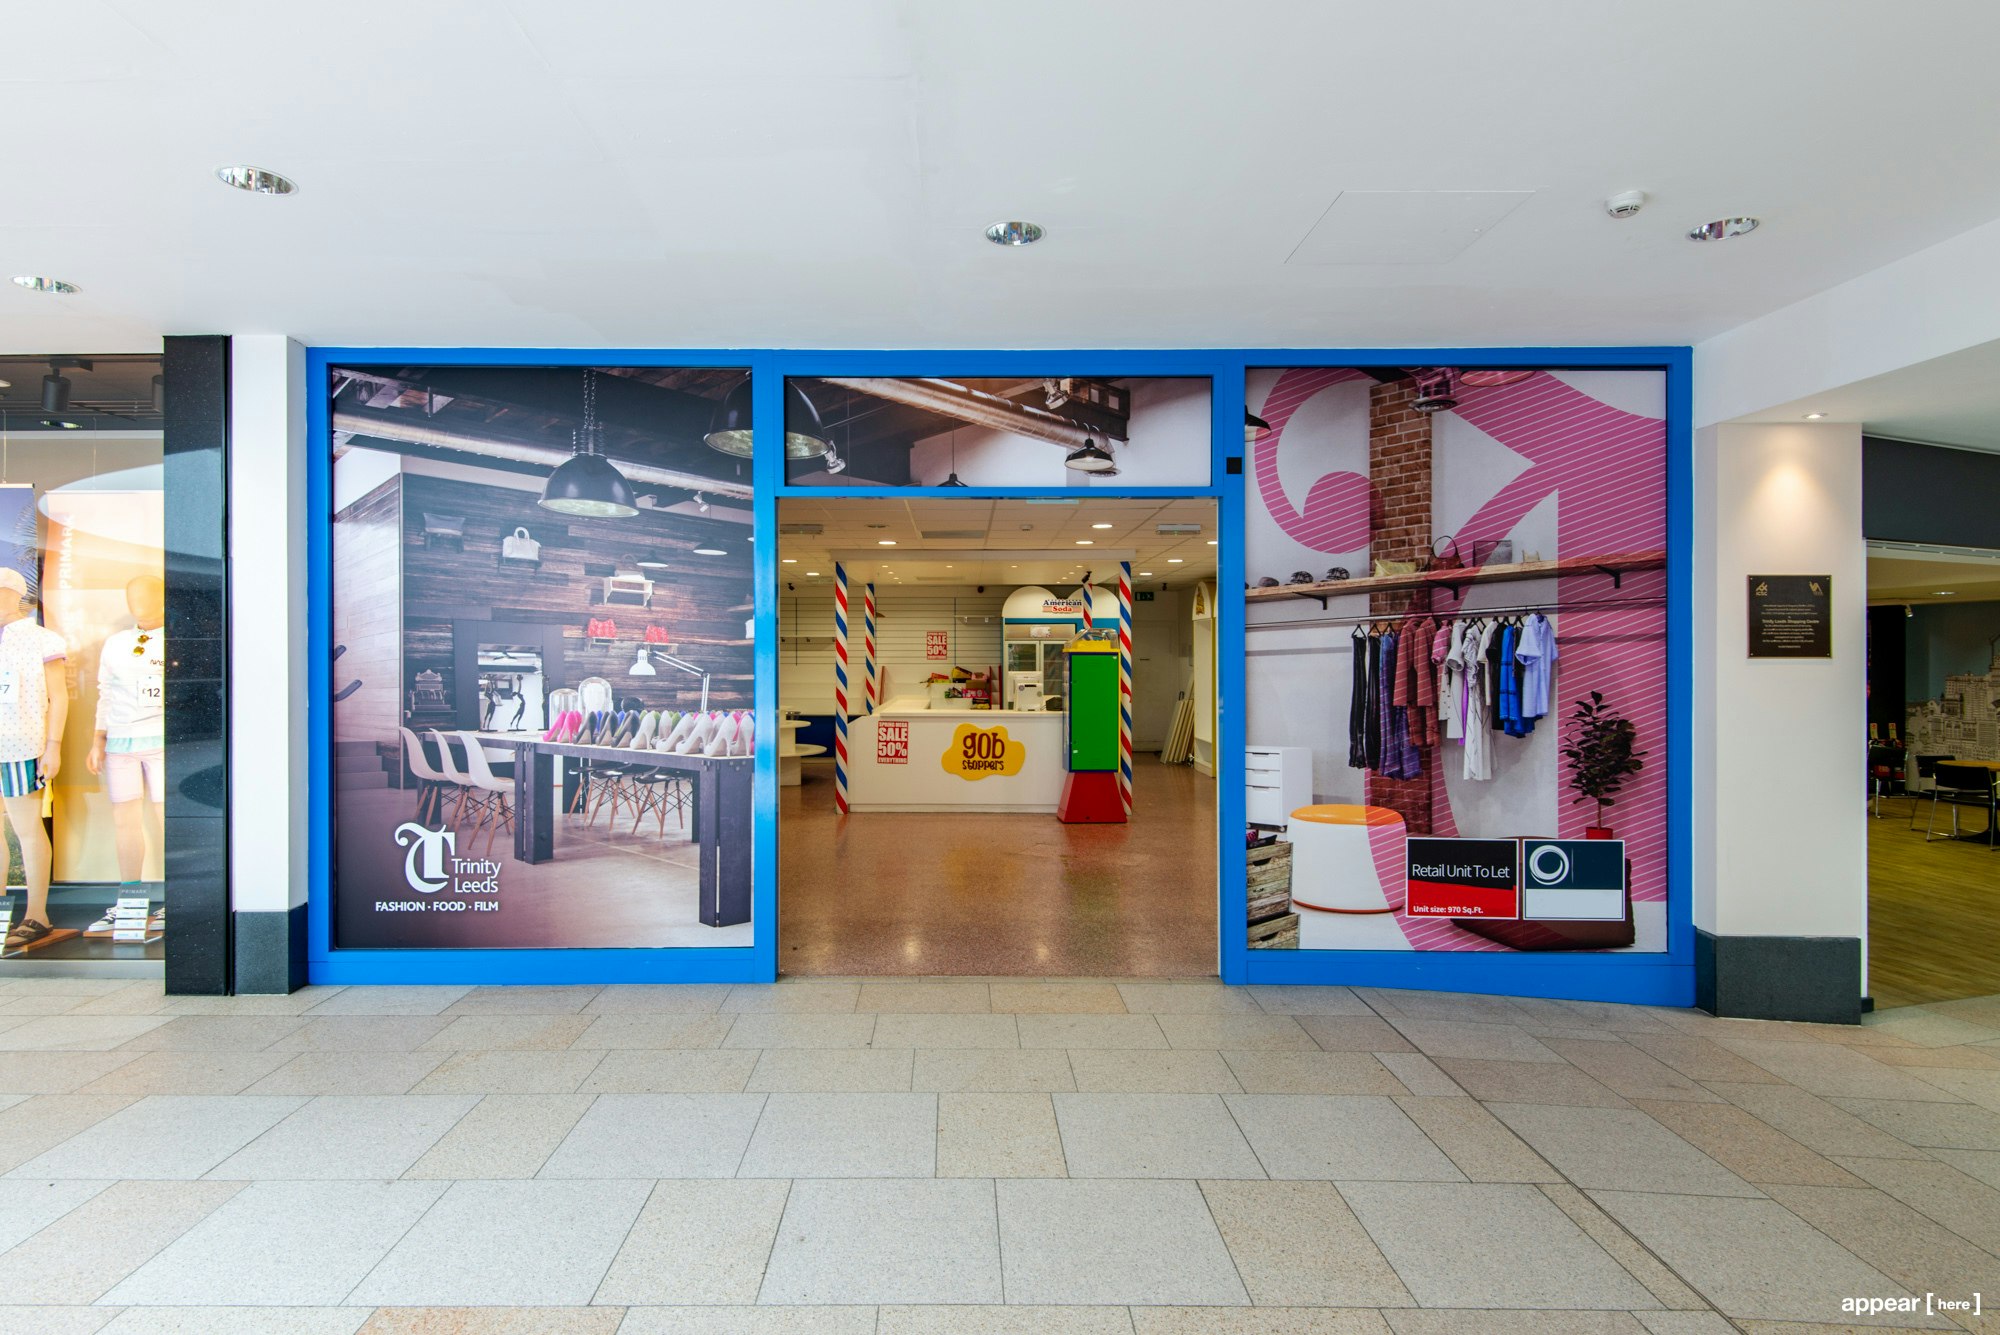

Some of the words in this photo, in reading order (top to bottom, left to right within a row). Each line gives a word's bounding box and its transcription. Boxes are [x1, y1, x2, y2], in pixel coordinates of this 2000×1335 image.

[928, 635, 947, 645] SALE
[928, 645, 947, 655] 50%
[878, 727, 908, 742] SALE
[878, 741, 908, 757] 50%
[962, 732, 1005, 759] gob
[962, 760, 1004, 771] stoppers
[451, 858, 502, 879] Trinity
[1412, 863, 1445, 877] Retail
[1447, 864, 1472, 878] Unit
[1473, 865, 1489, 878] To
[1491, 865, 1510, 879] Let
[454, 877, 499, 893] Leeds
[375, 901, 426, 912] FASHION
[433, 901, 466, 912] FOOD
[474, 901, 499, 912] FILM
[1413, 905, 1430, 913] Unit
[1430, 905, 1446, 913] size:
[1447, 906, 1461, 914] 970
[1462, 906, 1484, 915] Sq.Ft.
